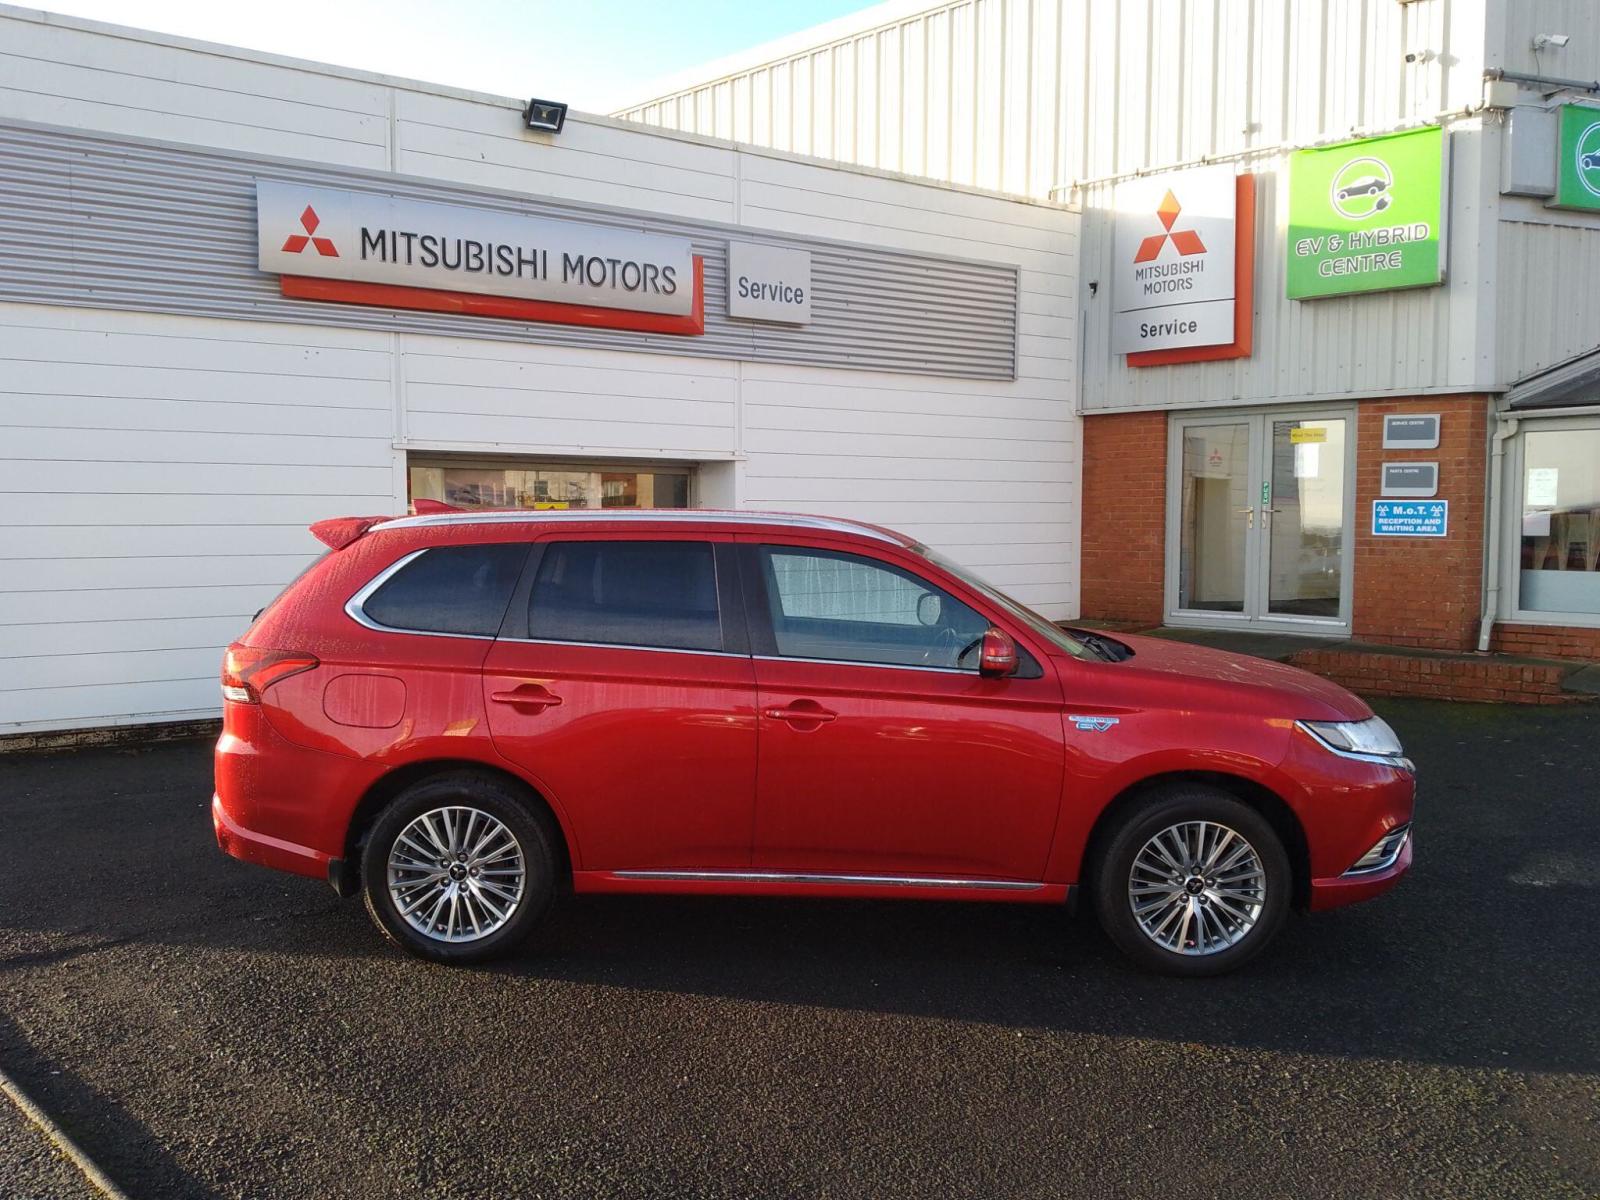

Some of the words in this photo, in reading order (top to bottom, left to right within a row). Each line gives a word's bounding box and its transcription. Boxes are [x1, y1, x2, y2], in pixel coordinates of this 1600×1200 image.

[1296, 236, 1324, 256] EV
[1328, 234, 1343, 252] &
[1349, 223, 1430, 250] HYBRID
[360, 227, 548, 281] MITSUBISHI
[562, 252, 677, 296] MOTORS
[1135, 260, 1204, 281] MITSUBISHI
[1318, 250, 1403, 277] CENTRE
[738, 275, 804, 305] Service
[1143, 277, 1193, 296] MOTORS
[1140, 319, 1198, 339] Service
[1392, 506, 1427, 515] M.o.T.
